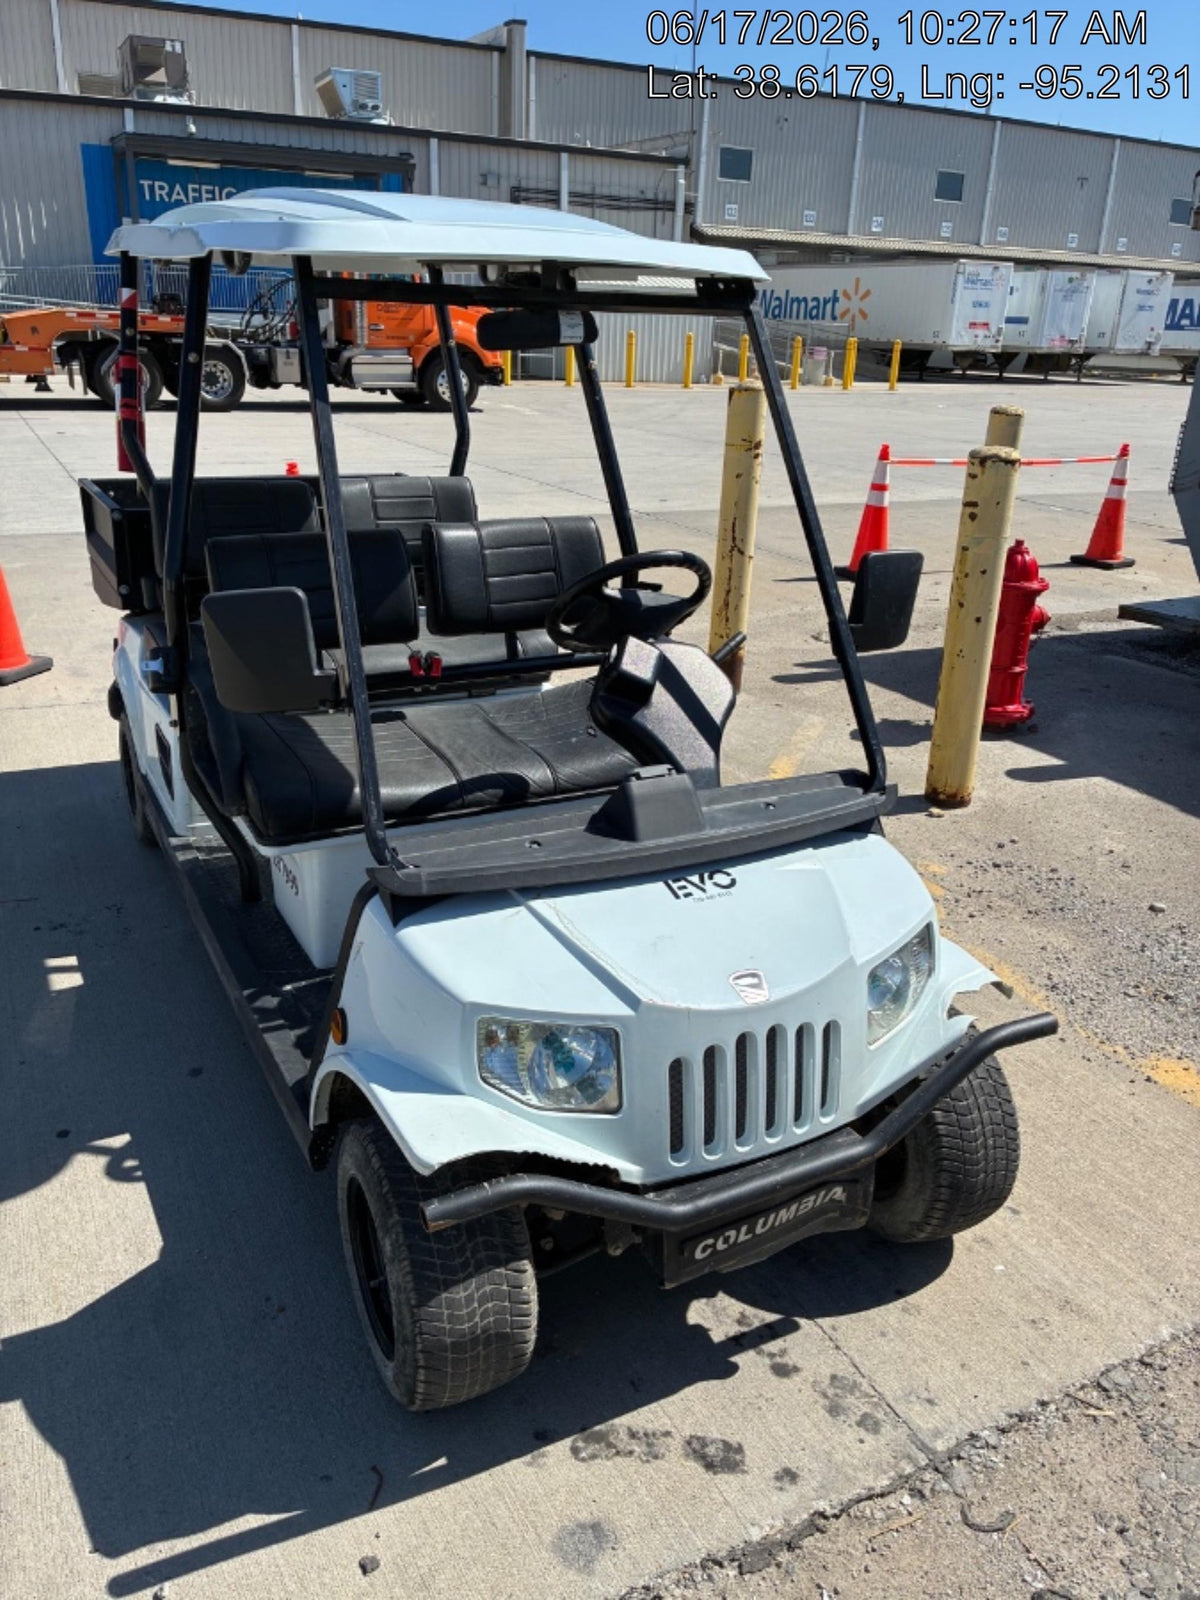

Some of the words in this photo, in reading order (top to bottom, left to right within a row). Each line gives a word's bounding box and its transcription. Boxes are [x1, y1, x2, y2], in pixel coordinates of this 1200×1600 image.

[139, 179, 237, 203] TRAFFIC
[663, 869, 737, 900] EVO
[694, 1185, 848, 1260] COLUMBIA
